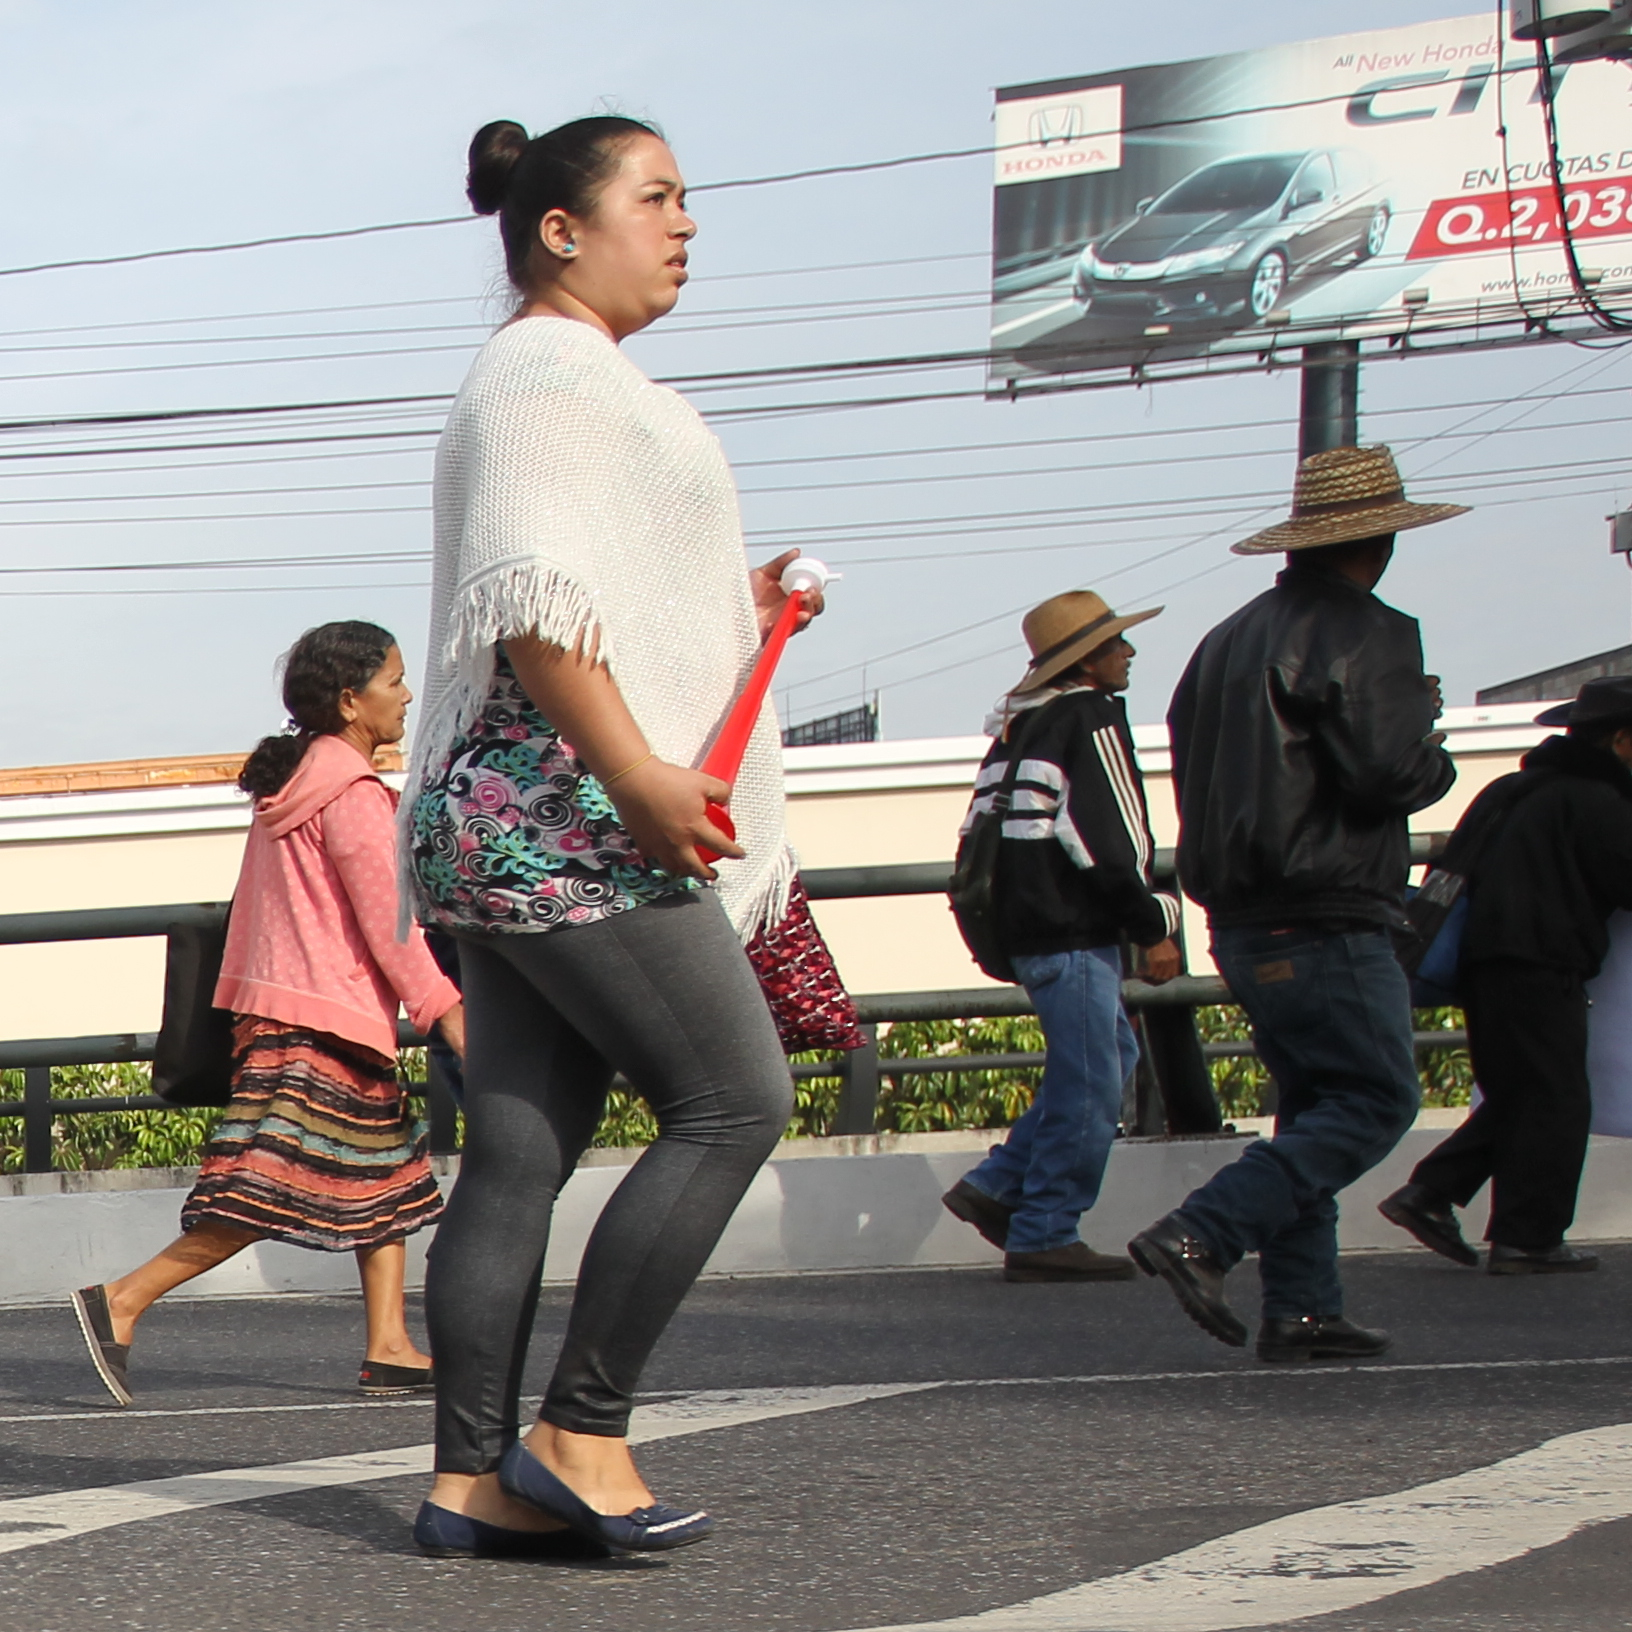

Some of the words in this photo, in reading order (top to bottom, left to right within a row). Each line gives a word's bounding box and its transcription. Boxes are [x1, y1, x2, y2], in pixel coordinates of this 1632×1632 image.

[1333, 54, 1354, 69] All
[1356, 50, 1416, 74] New
[1002, 148, 1107, 174] HONDA
[1461, 167, 1499, 190] EN
[1507, 152, 1611, 184] CUOTAS
[1436, 184, 1632, 245] Q.2,03
